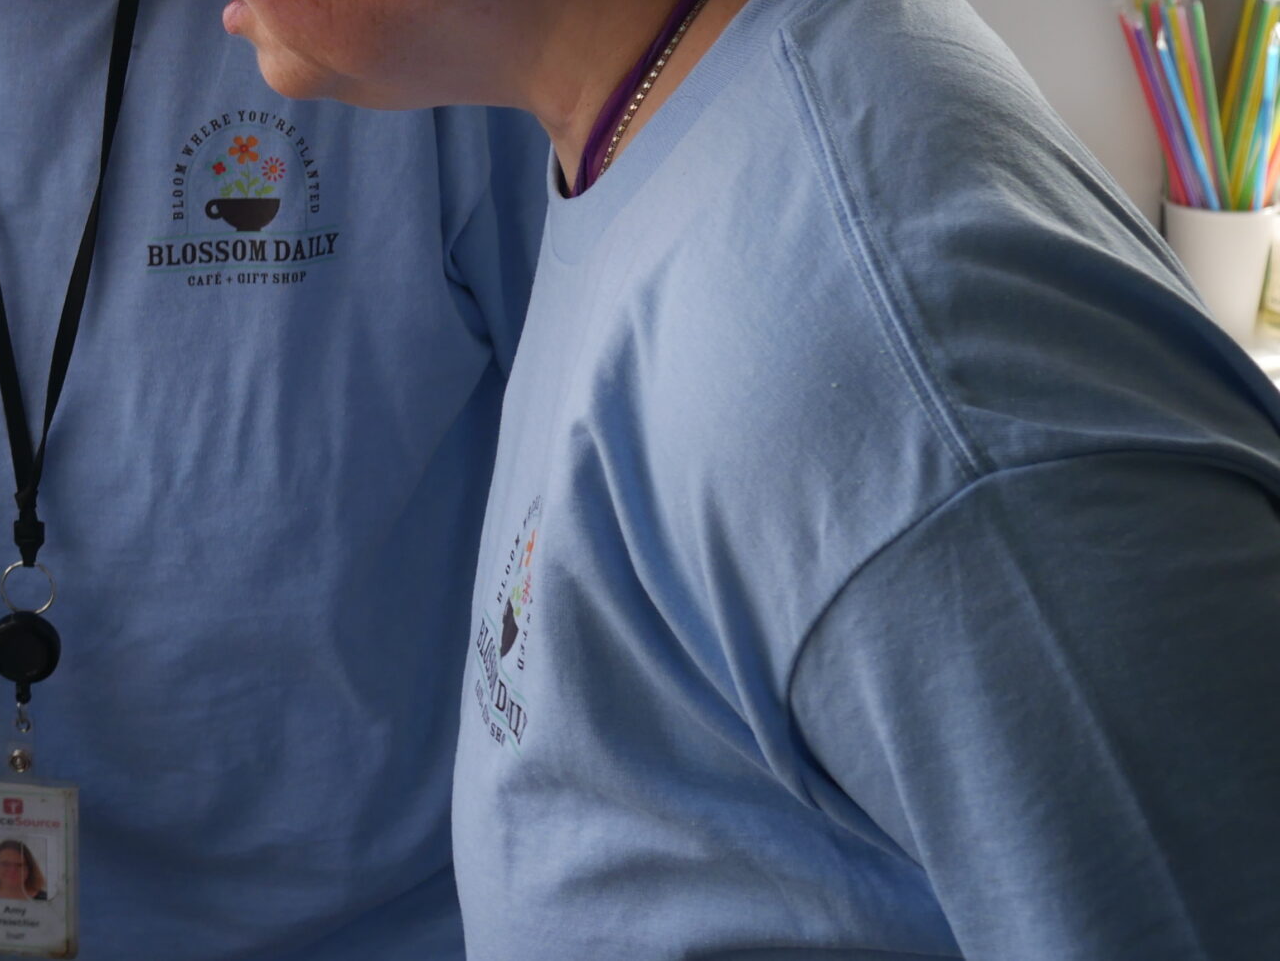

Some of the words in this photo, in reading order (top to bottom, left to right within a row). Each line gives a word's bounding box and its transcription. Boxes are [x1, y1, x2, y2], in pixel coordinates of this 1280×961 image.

[172, 163, 188, 221] BLOOM
[181, 113, 232, 158] WHERE
[237, 109, 297, 138] YOU'RE
[295, 136, 321, 214] PLANTED
[146, 240, 267, 267] BLOSSOM
[273, 232, 340, 263] DAILY
[237, 272, 269, 285] GIFT
[272, 270, 308, 285] SHOP
[3, 905, 27, 916] Amy
